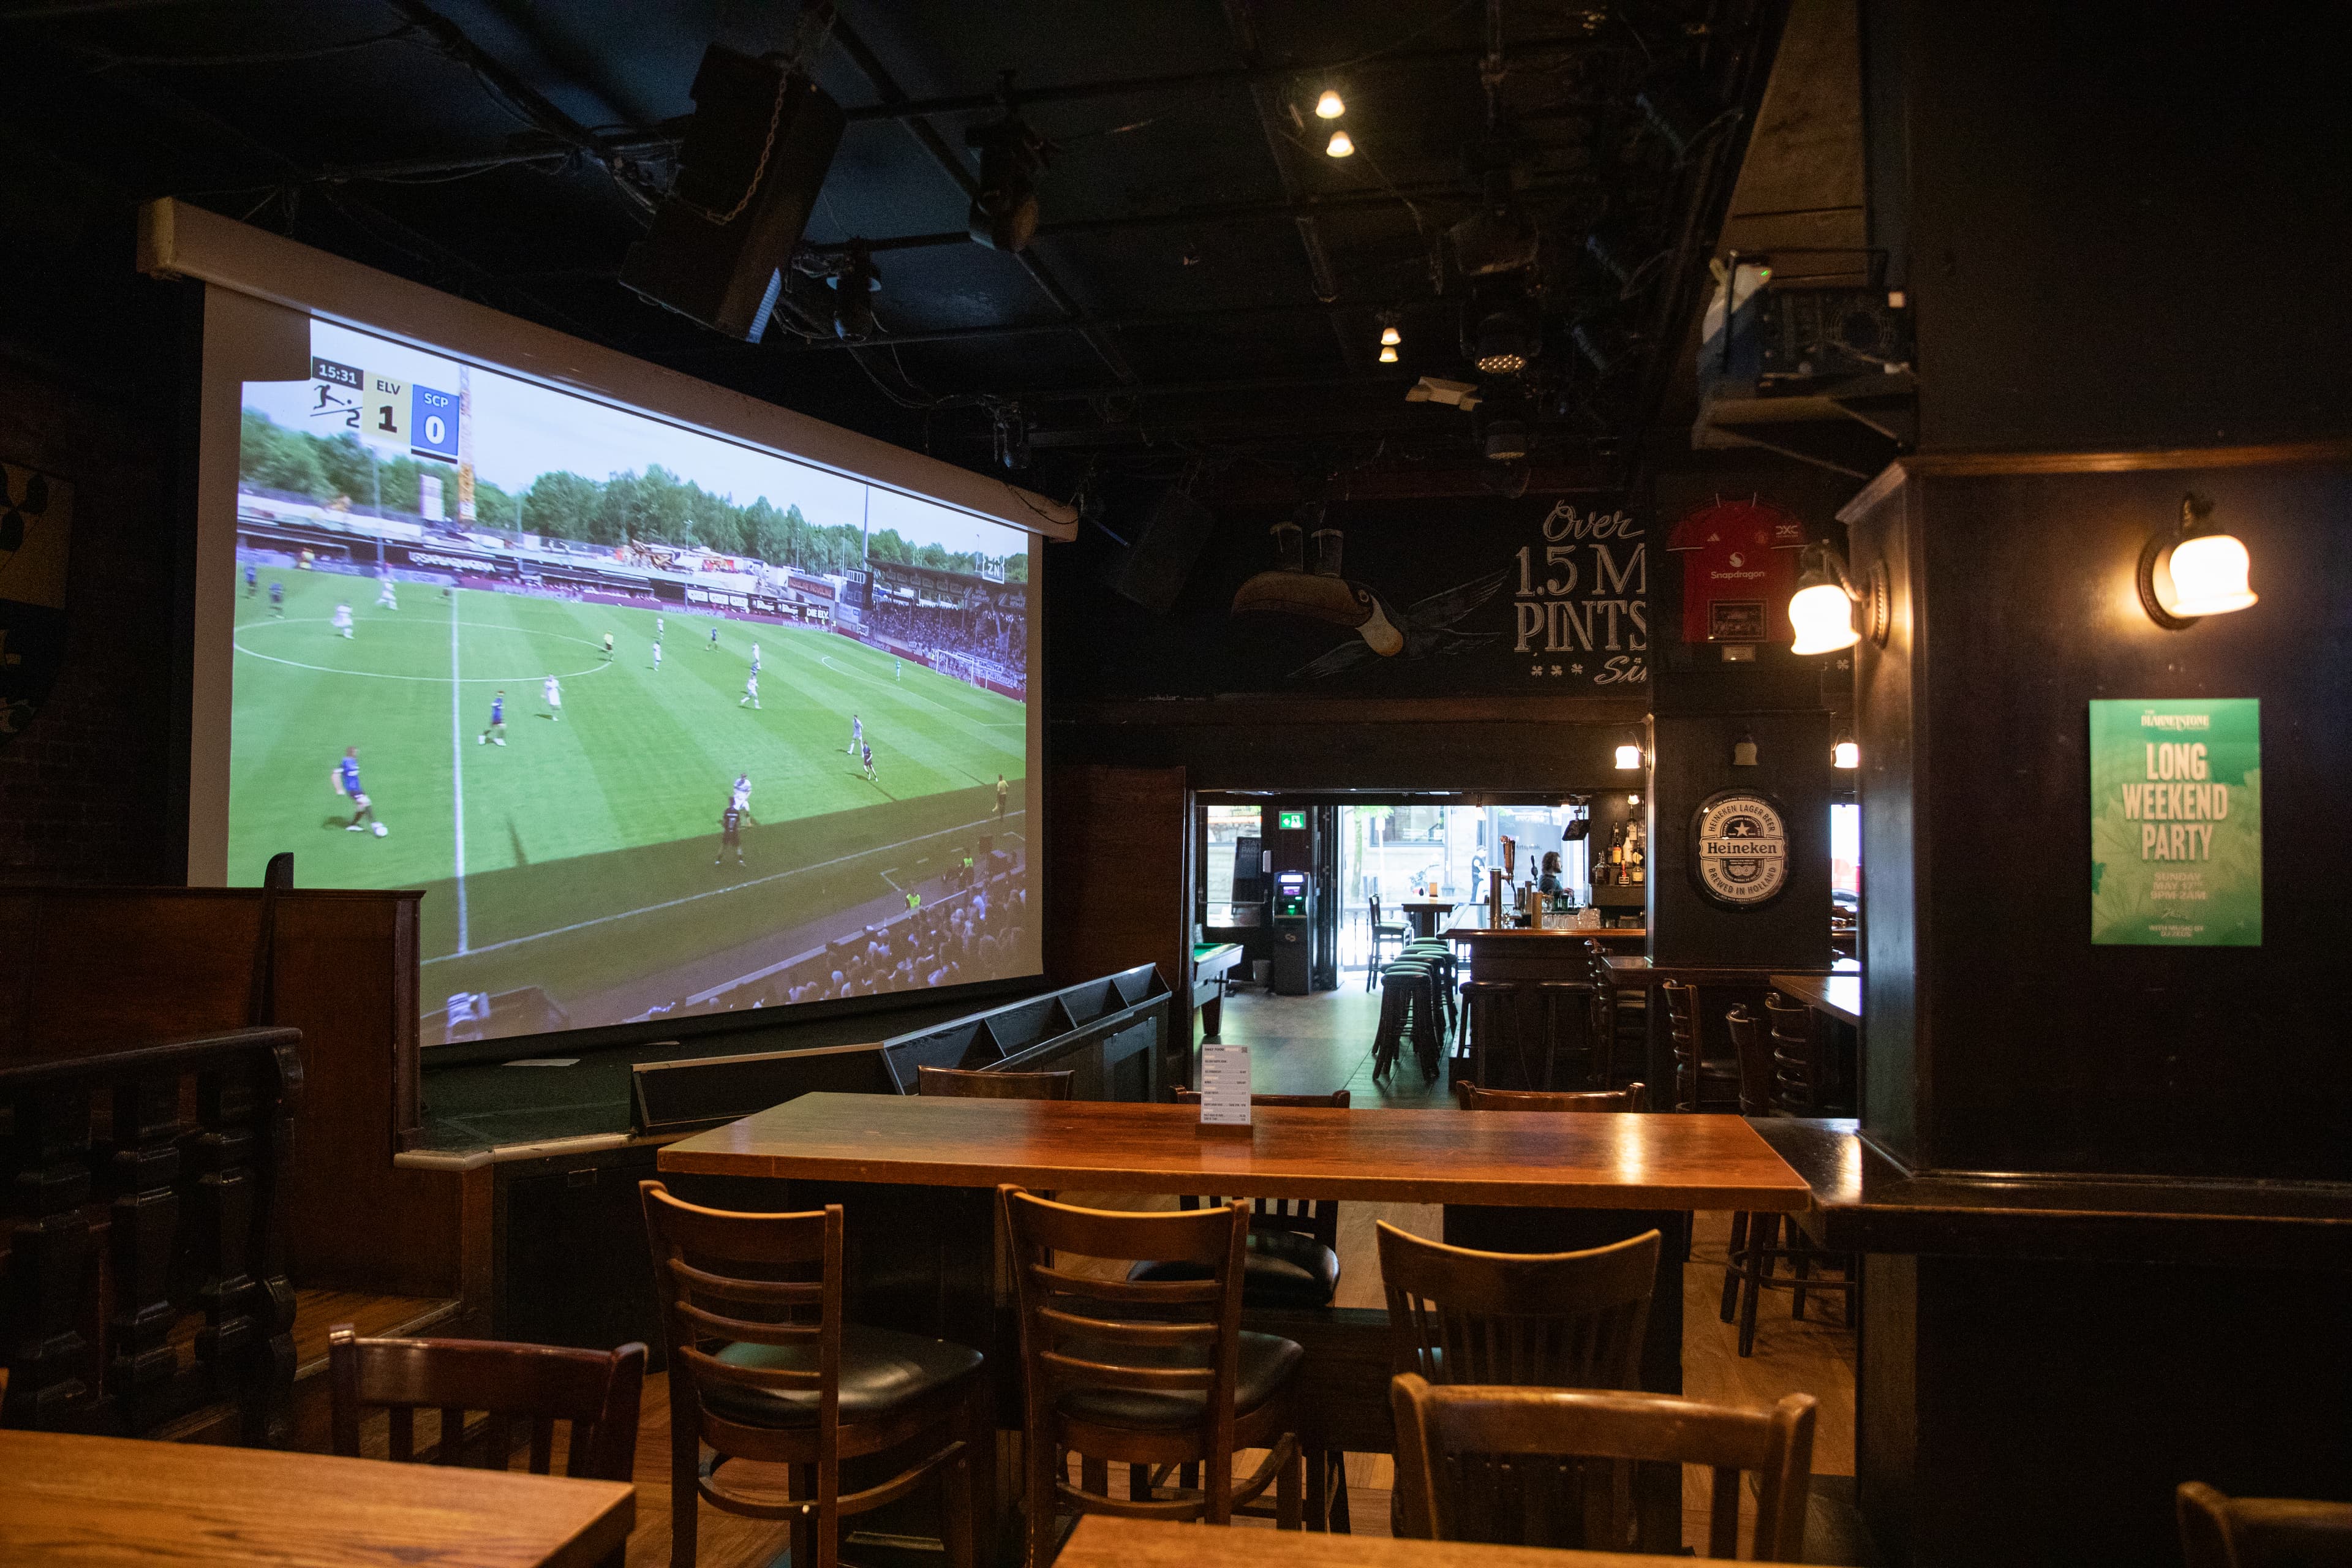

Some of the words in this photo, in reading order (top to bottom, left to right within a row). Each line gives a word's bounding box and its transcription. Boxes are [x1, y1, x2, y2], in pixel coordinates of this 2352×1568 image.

[318, 364, 356, 385] 15:31
[377, 380, 401, 395] ELV
[424, 393, 448, 408] SCP
[379, 405, 397, 433] 1
[425, 415, 445, 444] 0
[1542, 499, 1645, 541] Over
[1514, 545, 1577, 597] 1.5
[1711, 570, 1765, 580] Snapdragon
[1514, 600, 1646, 652] PINTS
[2146, 742, 2207, 780] LONG
[2122, 783, 2228, 820] WEEKEND
[1709, 805, 1736, 832] HEINEKEN
[1740, 805, 1763, 816] LAGER
[1762, 813, 1776, 832] BEER
[1707, 842, 1777, 854] Heineken
[2142, 824, 2213, 861] PARTY
[1709, 868, 1733, 892] BREWED
[1736, 886, 1745, 895] IN
[1747, 867, 1776, 894] HOLLAND
[2155, 872, 2201, 881] SUNDAY
